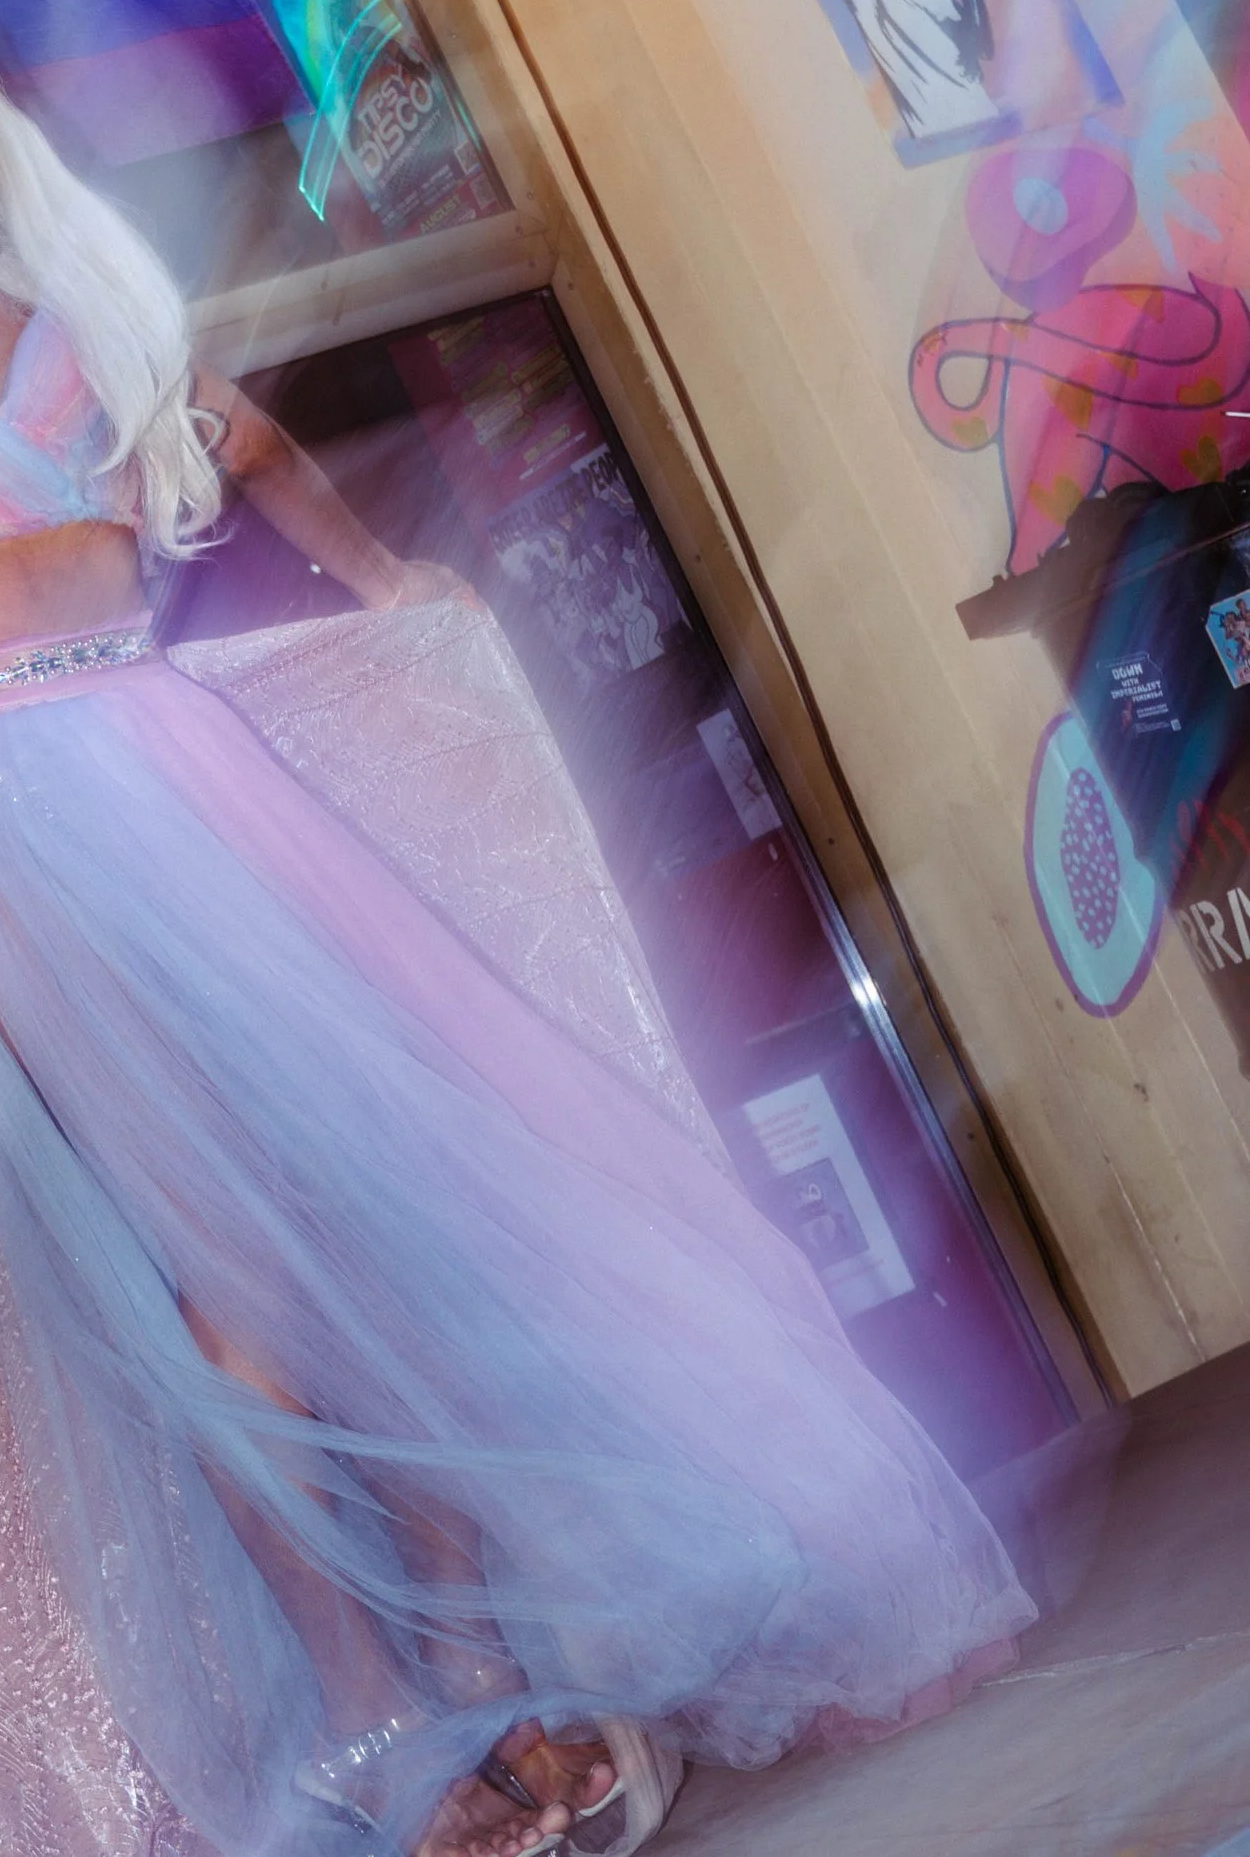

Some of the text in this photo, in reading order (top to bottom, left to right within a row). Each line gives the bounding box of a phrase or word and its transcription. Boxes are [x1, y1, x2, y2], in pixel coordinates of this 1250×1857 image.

[357, 77, 434, 179] DISCO
[1111, 663, 1143, 680] DOWN
[1121, 677, 1139, 688] WITH
